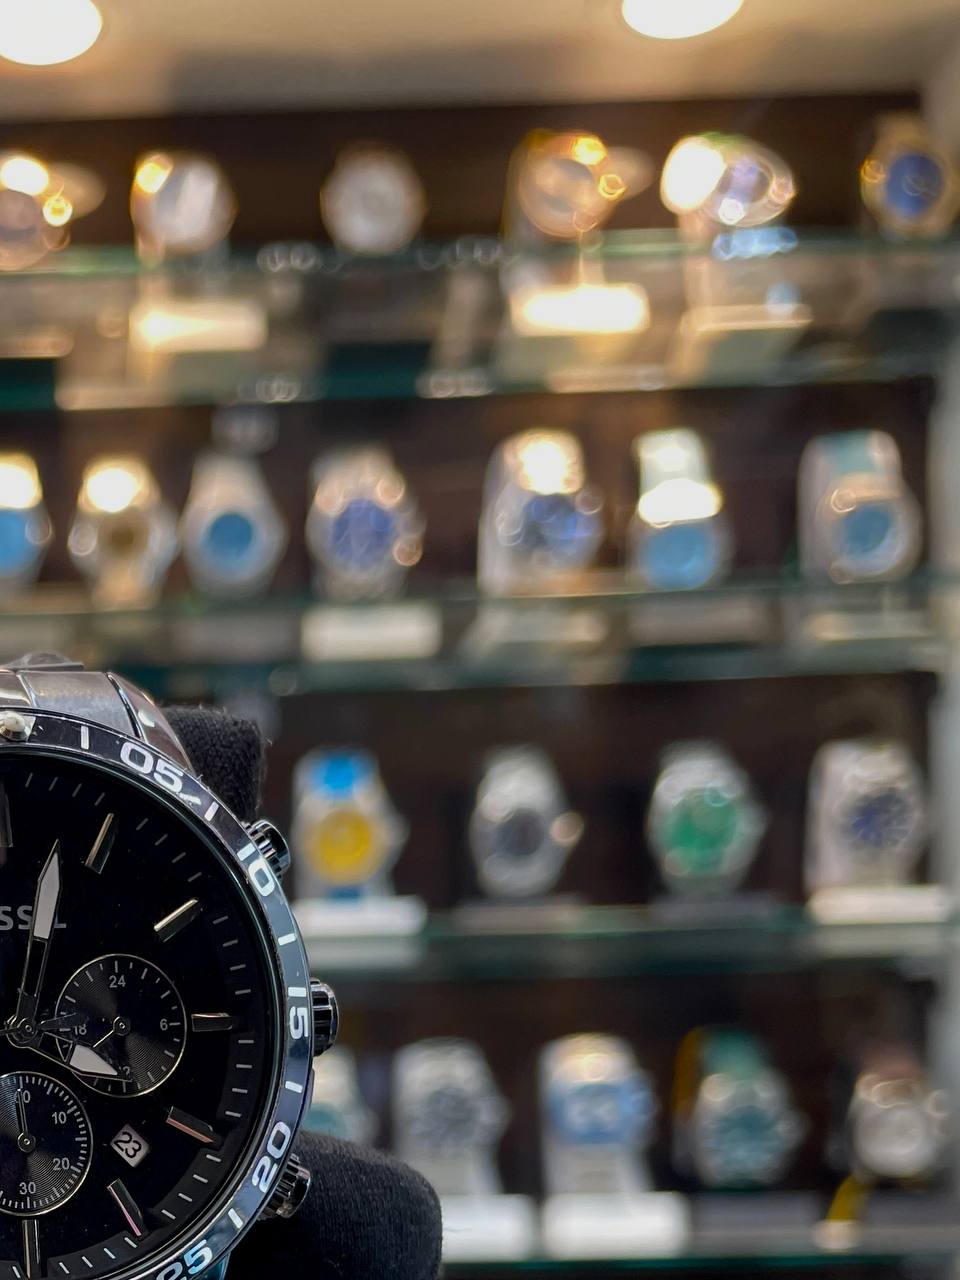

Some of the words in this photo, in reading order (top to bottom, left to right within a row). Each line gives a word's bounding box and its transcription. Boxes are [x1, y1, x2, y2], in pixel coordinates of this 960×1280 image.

[119, 741, 185, 796] 05
[236, 842, 276, 897] 10
[109, 975, 127, 988] 24
[288, 986, 309, 1040] 15
[159, 1018, 169, 1031] 6
[51, 1111, 68, 1125] 10
[114, 1131, 142, 1159] 23
[52, 1157, 70, 1171] 20
[251, 1121, 292, 1194] 20
[19, 1181, 37, 1195] 30
